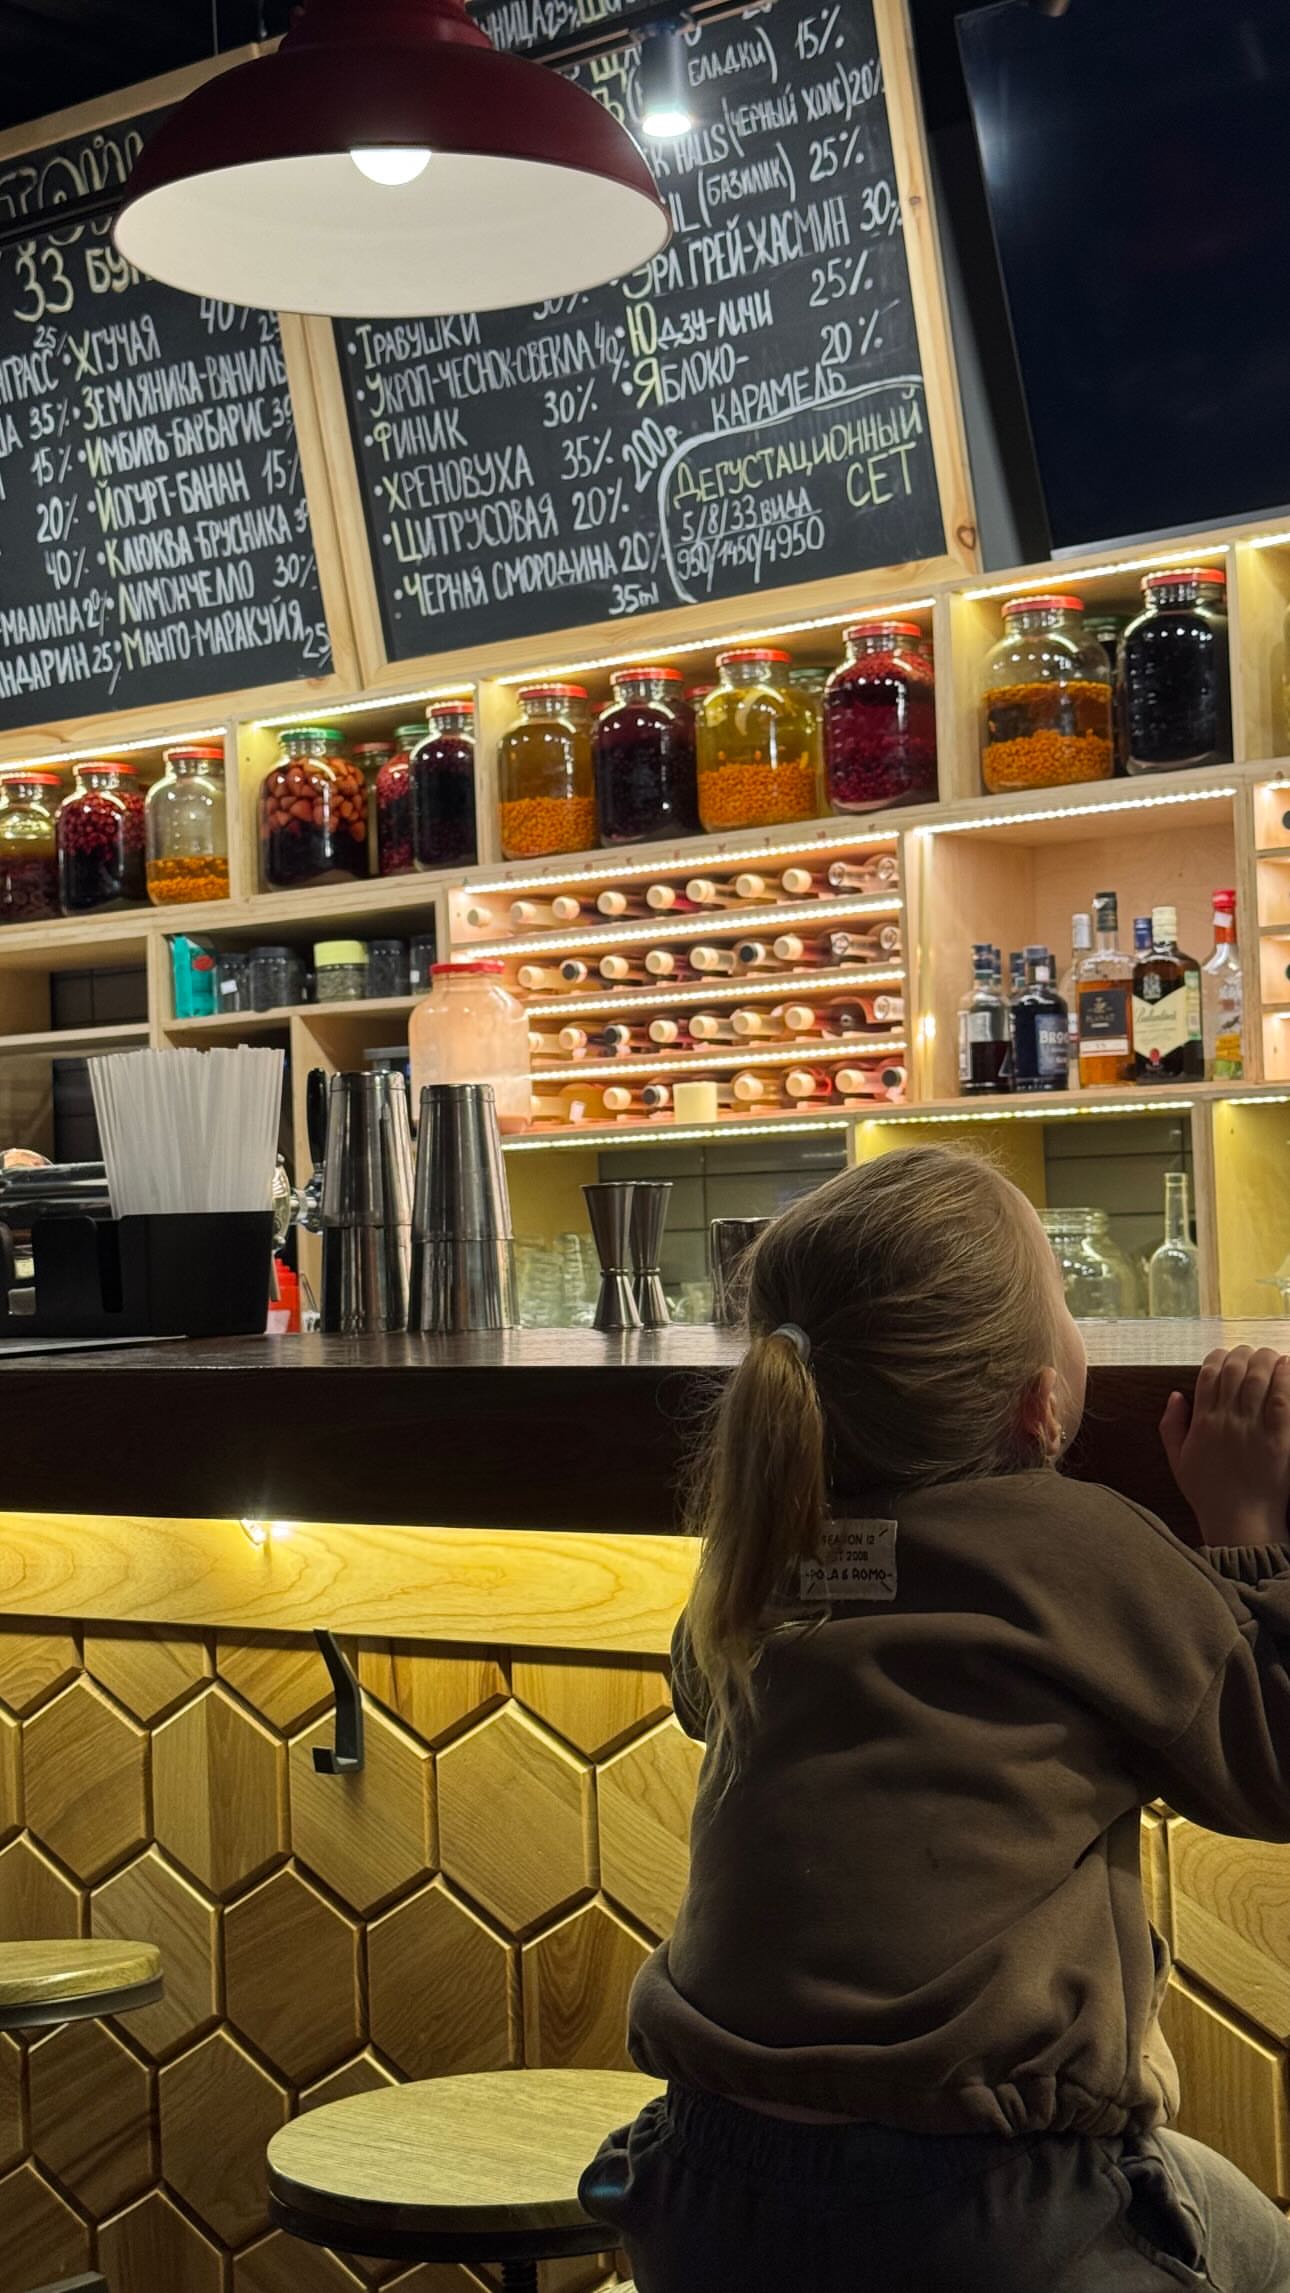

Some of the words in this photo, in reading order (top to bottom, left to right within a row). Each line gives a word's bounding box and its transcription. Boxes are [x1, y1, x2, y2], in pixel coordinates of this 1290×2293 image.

[795, 4, 845, 60] 15%
[809, 126, 865, 182] 25%
[626, 288, 774, 357] ЮДЗУ-ЛИЧИ
[809, 249, 874, 307] 25%
[819, 309, 884, 367] 20%
[67, 313, 161, 382] ЖГУЧАЯ
[355, 311, 481, 370] ТРАВУШКИ
[29, 398, 71, 440] 35%
[81, 343, 289, 432] ЗЕМЛЯНИКА-ВАНИЛЬ
[373, 407, 468, 462] ФИНИК
[542, 377, 599, 428] 30%
[710, 361, 847, 433] КАРАМЕЛЬ
[31, 444, 73, 488] 15%
[84, 397, 272, 479] ИМБИРЬ-БАРБАРИС
[382, 444, 535, 514] ХРЕНОВУХА
[560, 427, 614, 481] 35%
[673, 387, 923, 510] ДЕГУСТАЦИОННЫЙ
[846, 440, 917, 508] СЕТ
[36, 493, 80, 543] 20%
[95, 457, 251, 533] ЙОГУРТ-БАНАН
[390, 492, 560, 566] ЦИТРУСОВАЯ
[571, 476, 630, 532] 20%
[759, 485, 813, 525] ВИДА
[44, 546, 90, 591] 40%
[118, 557, 256, 626] ЛИМОНЧЕЛЛО
[272, 552, 317, 589] 30%
[402, 565, 490, 617] ЧЕРНАЯ
[491, 540, 619, 601] СМОРОДИНА
[618, 531, 667, 575] 20%
[120, 595, 305, 673] МАНГО-МАРАКУЙЯ
